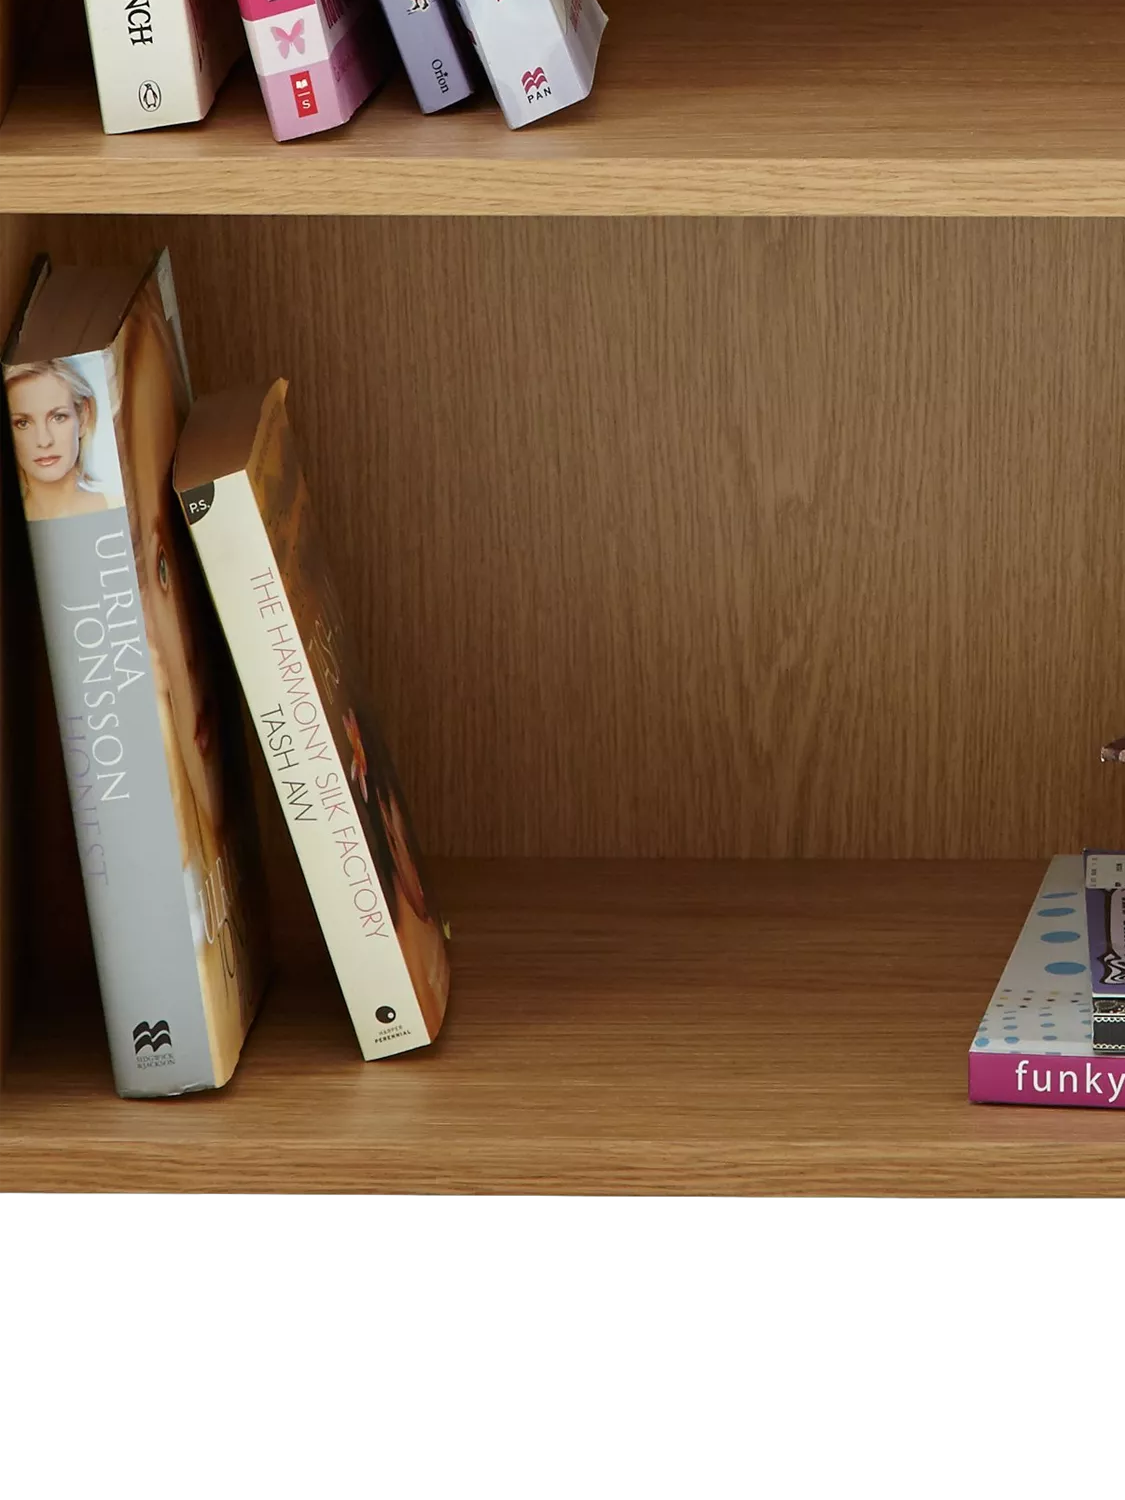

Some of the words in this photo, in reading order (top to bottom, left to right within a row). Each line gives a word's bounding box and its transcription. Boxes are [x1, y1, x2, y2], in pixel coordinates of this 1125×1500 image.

[430, 57, 450, 94] Orion
[527, 86, 553, 104] PAN
[188, 498, 211, 514] P.S.
[94, 528, 146, 694] ULRIKA
[250, 566, 285, 619] THE
[61, 602, 130, 802] JONSSON
[266, 623, 332, 761] HARMONY
[260, 703, 300, 771] TASH
[281, 779, 318, 823] AW
[315, 771, 350, 821] SILK
[332, 826, 390, 940] FACTORY
